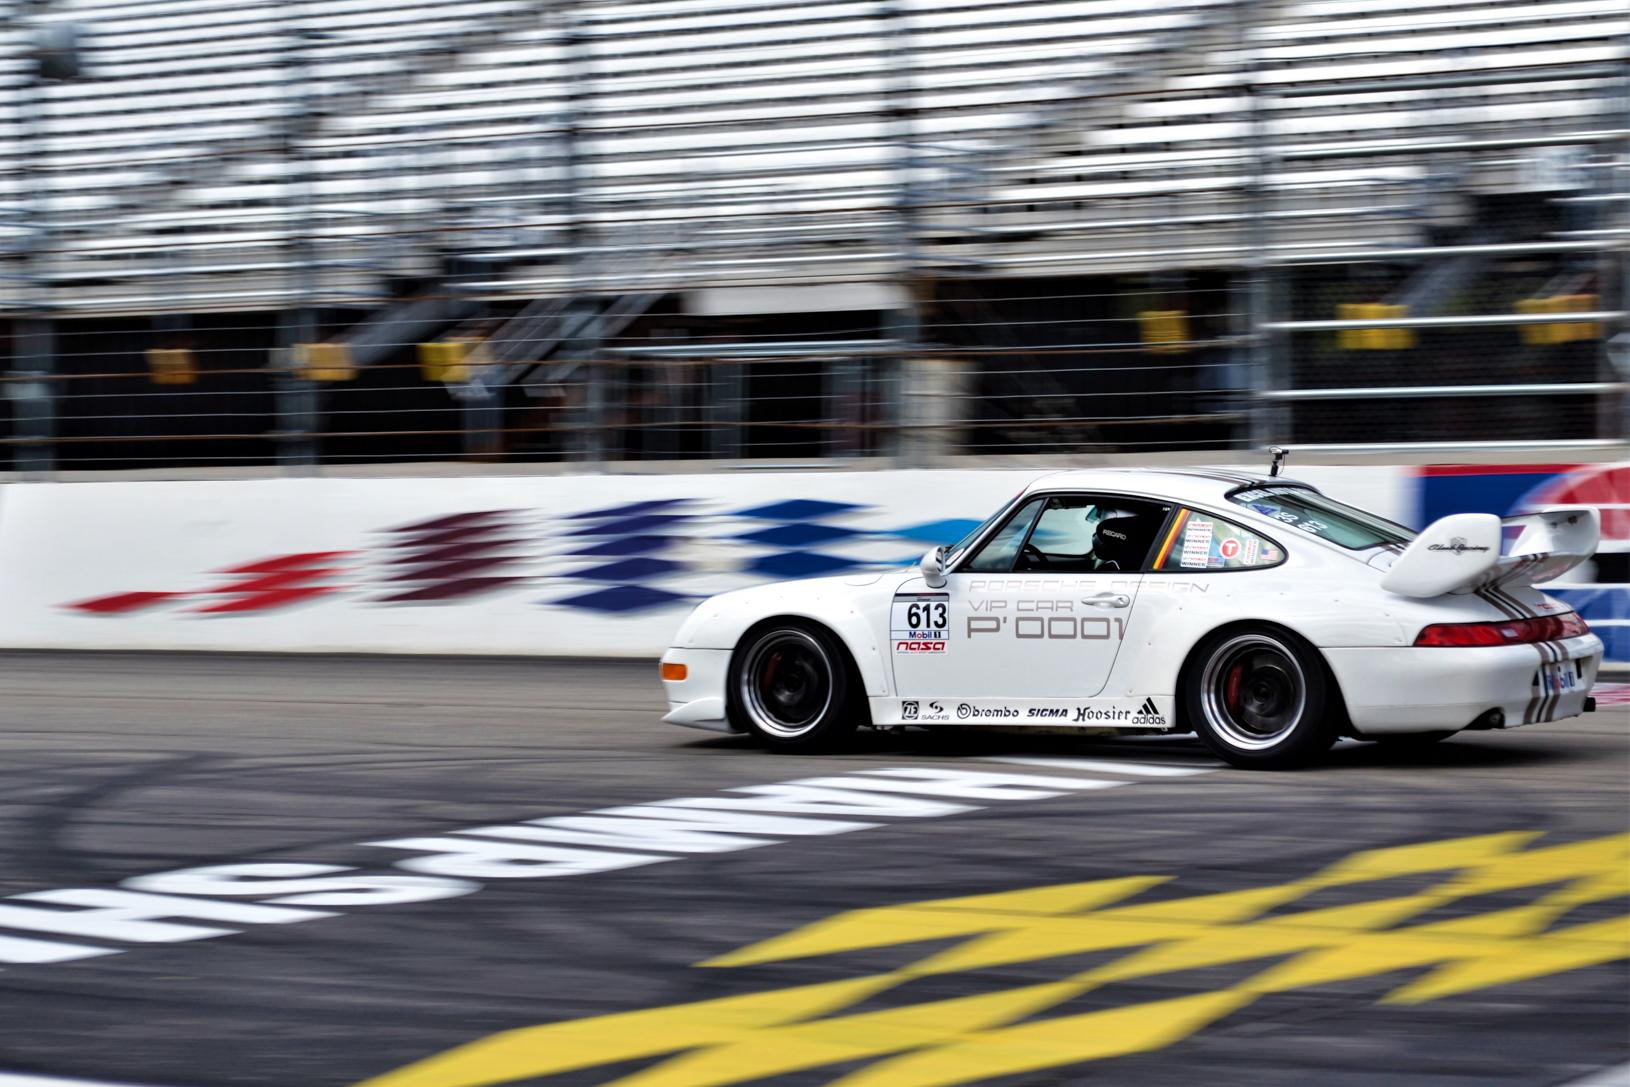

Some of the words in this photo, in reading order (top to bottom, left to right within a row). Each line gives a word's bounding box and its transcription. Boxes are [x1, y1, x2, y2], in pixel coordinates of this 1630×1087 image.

[1102, 529, 1127, 540] RECARO
[969, 580, 1097, 592] PORSCHE
[1111, 580, 1210, 593] DESIGN
[968, 600, 1008, 612] VIP
[1017, 600, 1074, 612] CAR
[907, 603, 947, 629] 613
[909, 631, 932, 639] Mobil
[896, 641, 946, 651] nasa
[972, 706, 1019, 718] brembo
[1027, 708, 1068, 717] SIGMA
[1072, 705, 1131, 722] Hoosier
[1132, 714, 1166, 724] adidas
